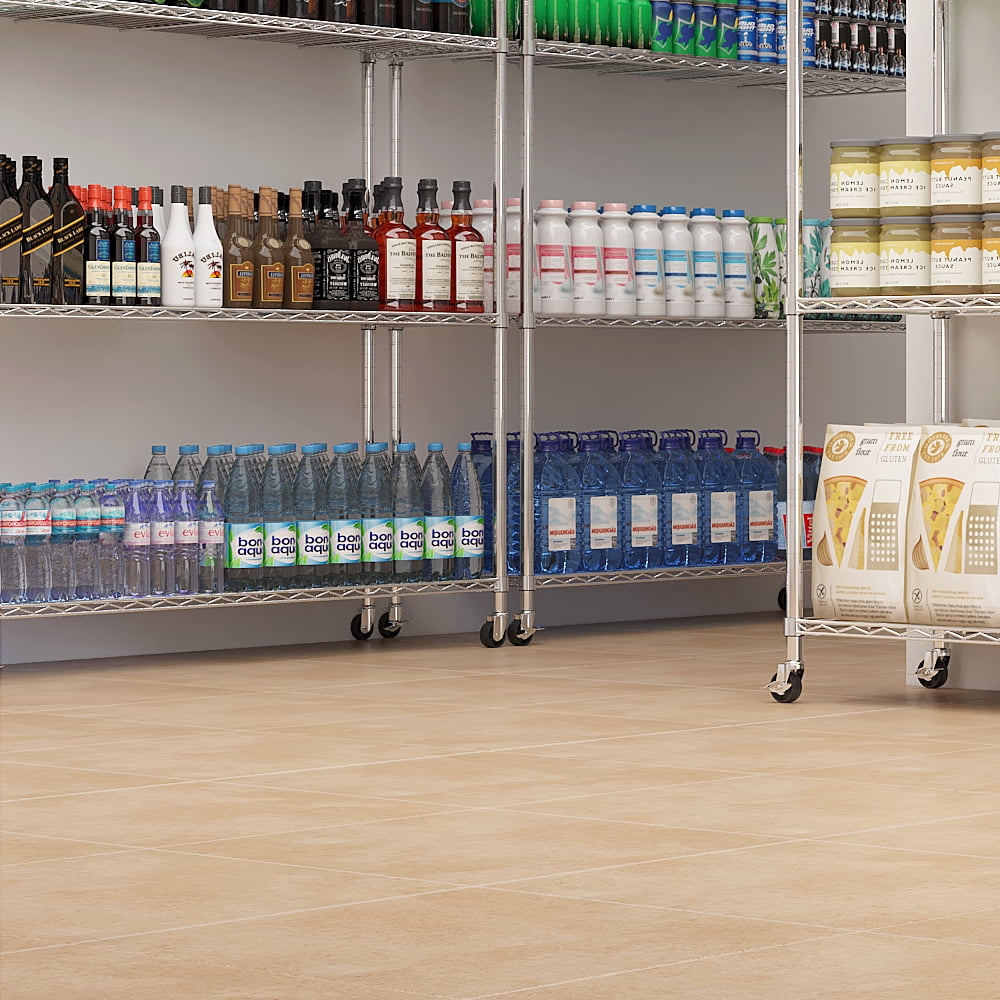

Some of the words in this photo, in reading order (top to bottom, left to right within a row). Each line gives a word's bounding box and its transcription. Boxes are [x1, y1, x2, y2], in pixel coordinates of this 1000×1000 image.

[888, 431, 914, 441] FREE
[859, 437, 878, 447] gram
[956, 438, 976, 448] gram
[855, 448, 871, 456] flour
[884, 443, 910, 452] FROM
[952, 449, 968, 458] flour
[880, 455, 907, 464] GLUTEN
[238, 537, 263, 547] bon
[271, 535, 295, 546] bon
[305, 534, 329, 544] bon
[337, 533, 361, 543] bon
